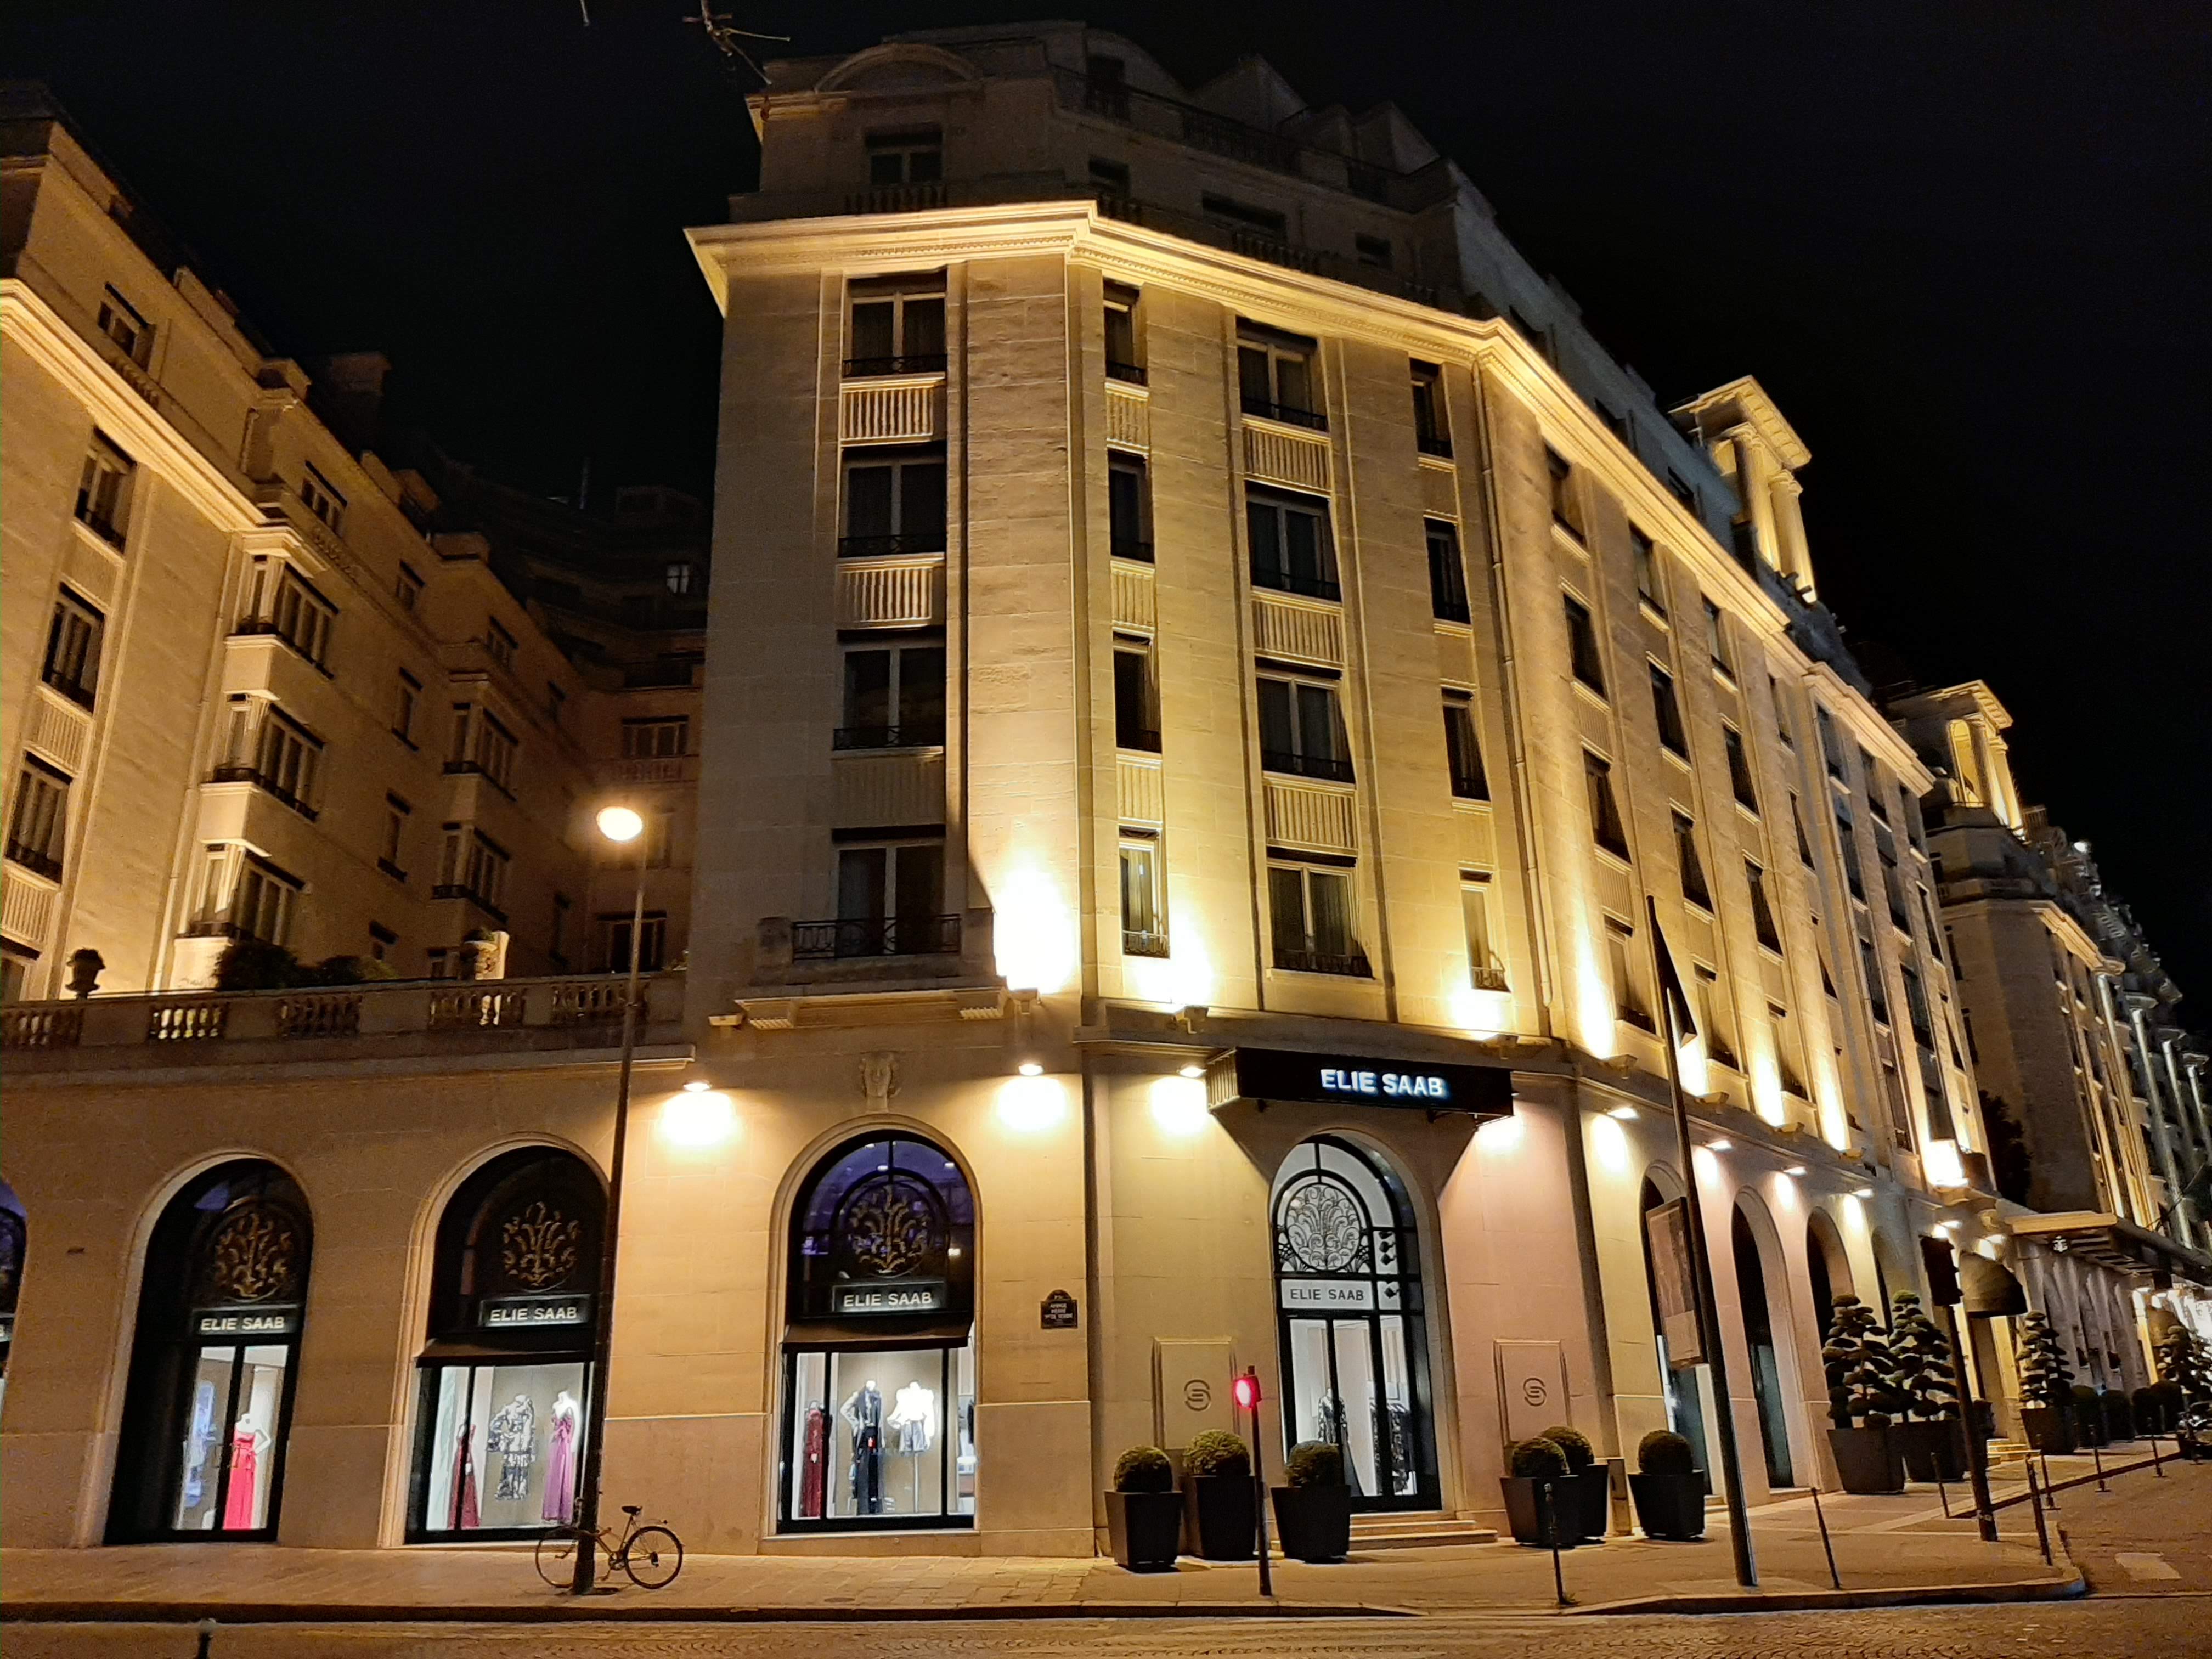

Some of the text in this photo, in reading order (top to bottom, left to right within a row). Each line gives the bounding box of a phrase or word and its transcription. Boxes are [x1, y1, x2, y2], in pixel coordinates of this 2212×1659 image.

[1321, 1069, 1445, 1097] ELIE SAAB
[843, 1291, 932, 1307] ELIE SAAB
[1290, 1289, 1364, 1301] ELIE SAAB
[490, 1307, 577, 1322] ELIE SAAB
[201, 1317, 285, 1331] ELIE SAAB
